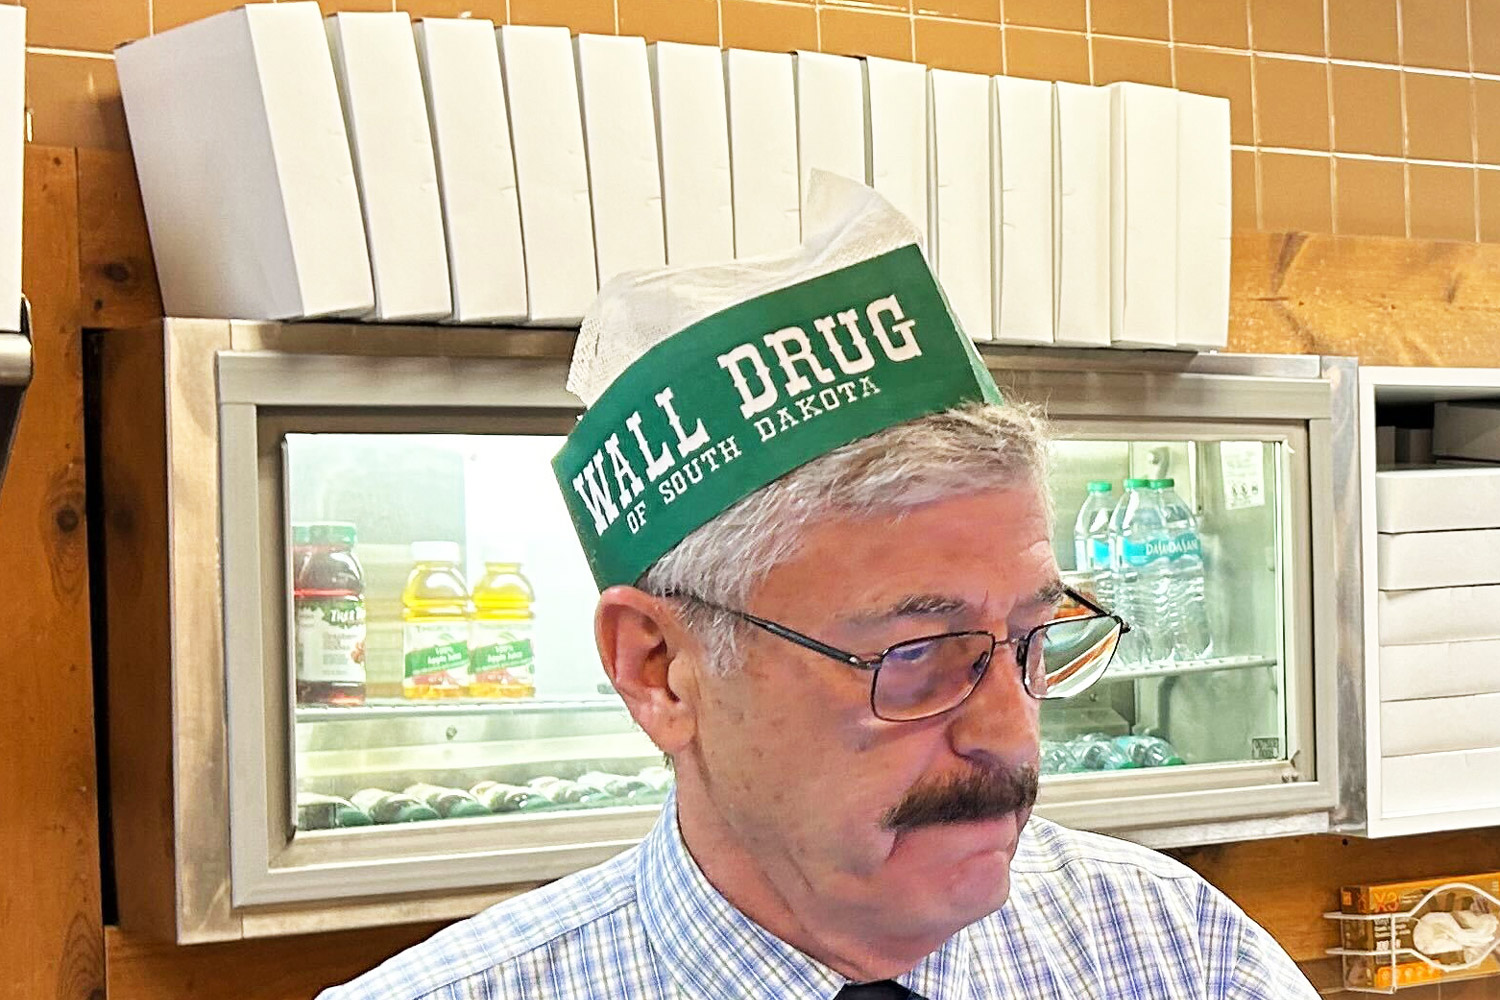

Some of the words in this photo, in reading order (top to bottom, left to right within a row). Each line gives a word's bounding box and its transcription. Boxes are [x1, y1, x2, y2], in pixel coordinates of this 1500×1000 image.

[573, 387, 711, 537] WALL
[717, 294, 923, 420] DRUG
[625, 501, 648, 535] OF
[658, 435, 742, 505] SOUTH
[754, 376, 881, 442] DAKOTA
